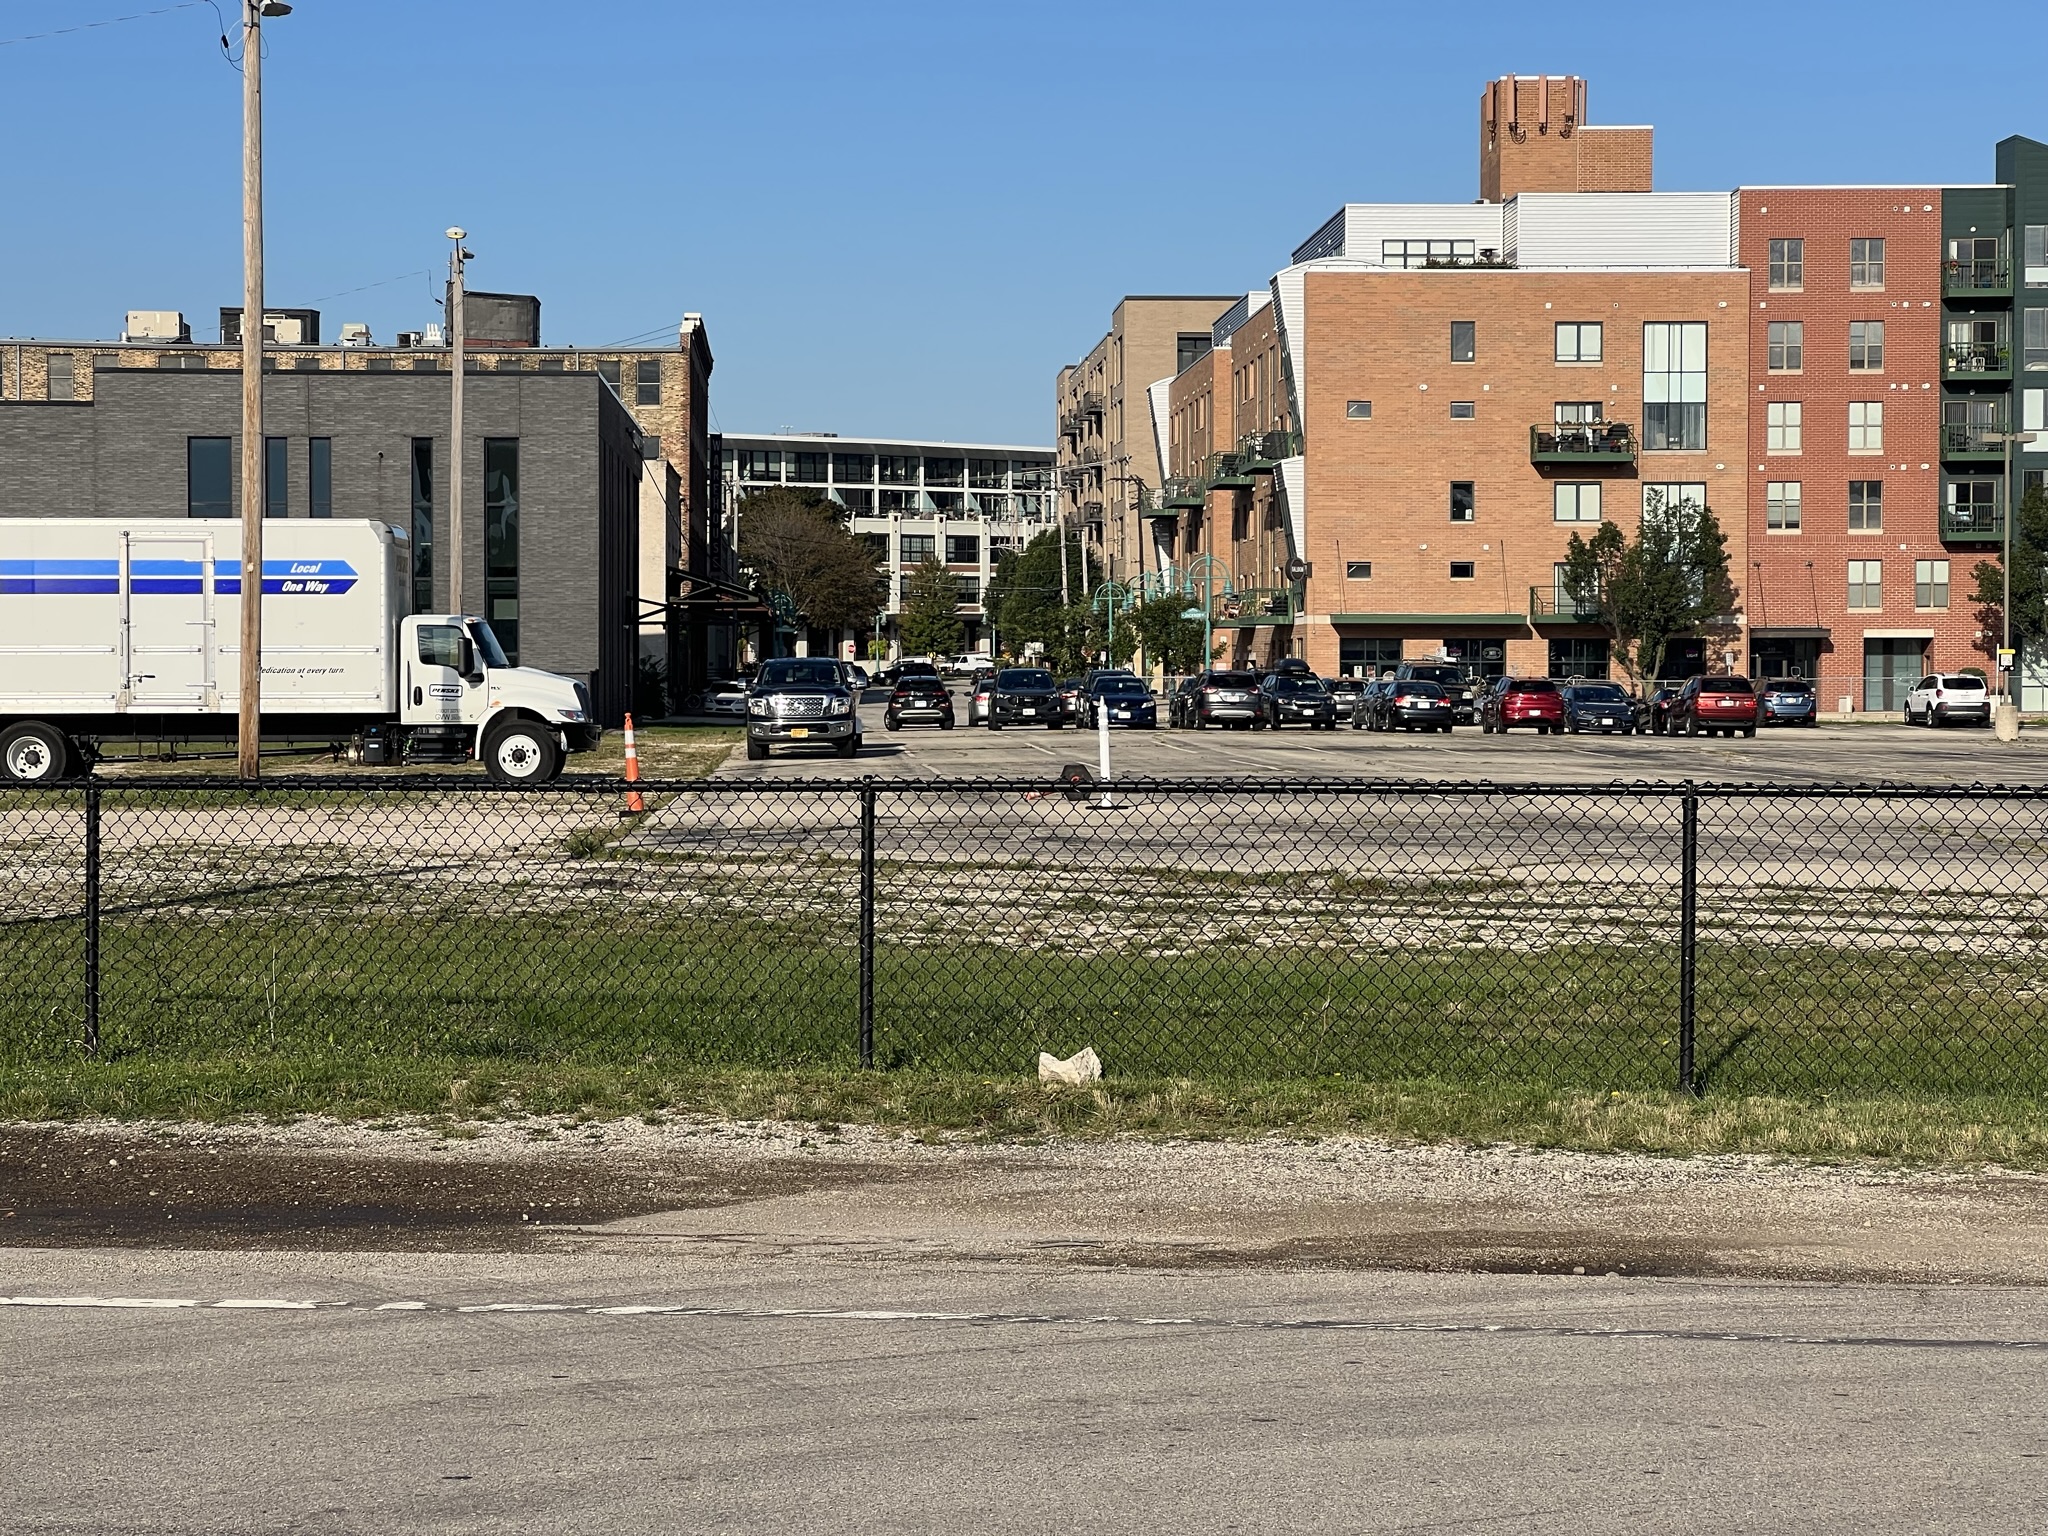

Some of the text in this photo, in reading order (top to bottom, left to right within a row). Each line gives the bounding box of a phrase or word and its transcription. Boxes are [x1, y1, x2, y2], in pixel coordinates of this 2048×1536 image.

[290, 562, 322, 574] Local
[282, 581, 330, 594] One Way
[297, 666, 306, 674] at
[306, 667, 328, 675] every
[328, 666, 346, 674] turn.
